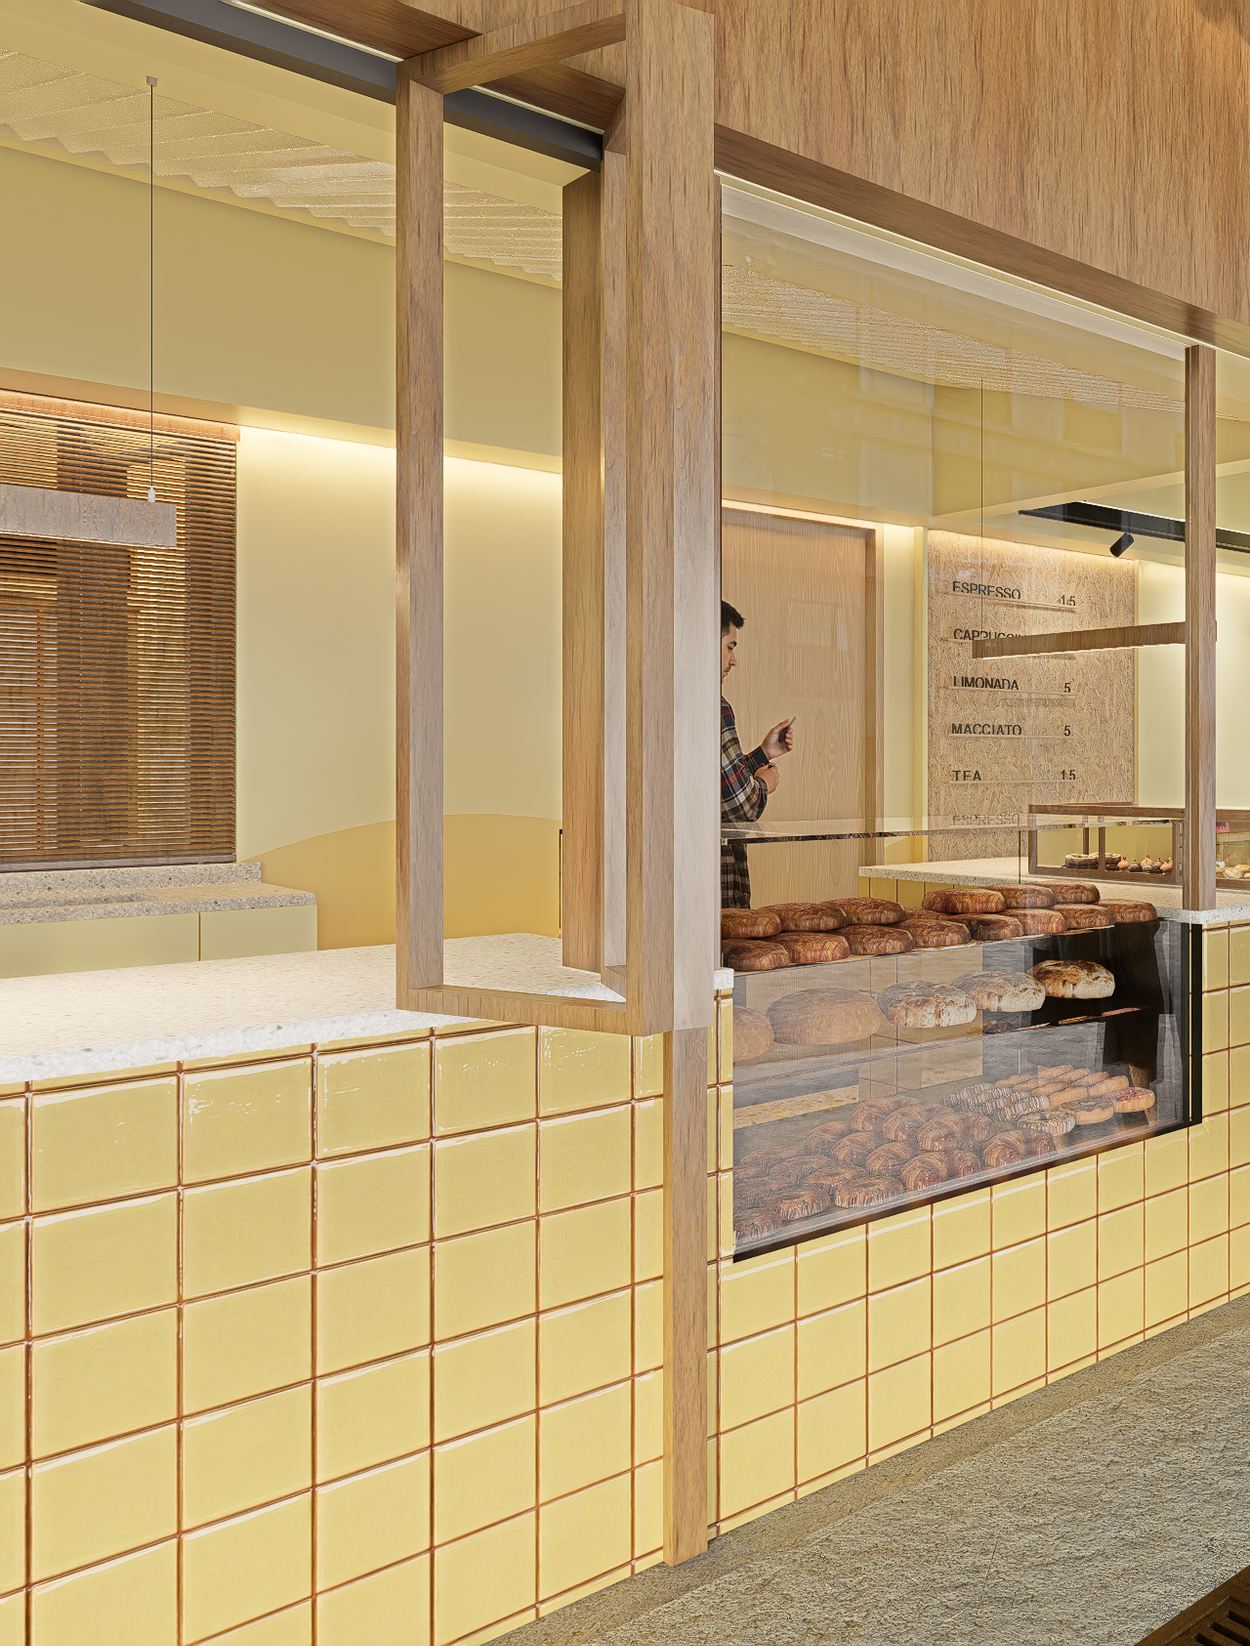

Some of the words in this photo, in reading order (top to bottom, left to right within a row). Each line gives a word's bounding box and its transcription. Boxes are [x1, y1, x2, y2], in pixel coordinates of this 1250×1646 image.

[952, 580, 1021, 600] ESPRESSO
[953, 675, 1019, 690] LIMONADA
[951, 723, 1022, 736] MACCIATO
[1063, 725, 1071, 736] 5
[952, 770, 982, 782] TEA
